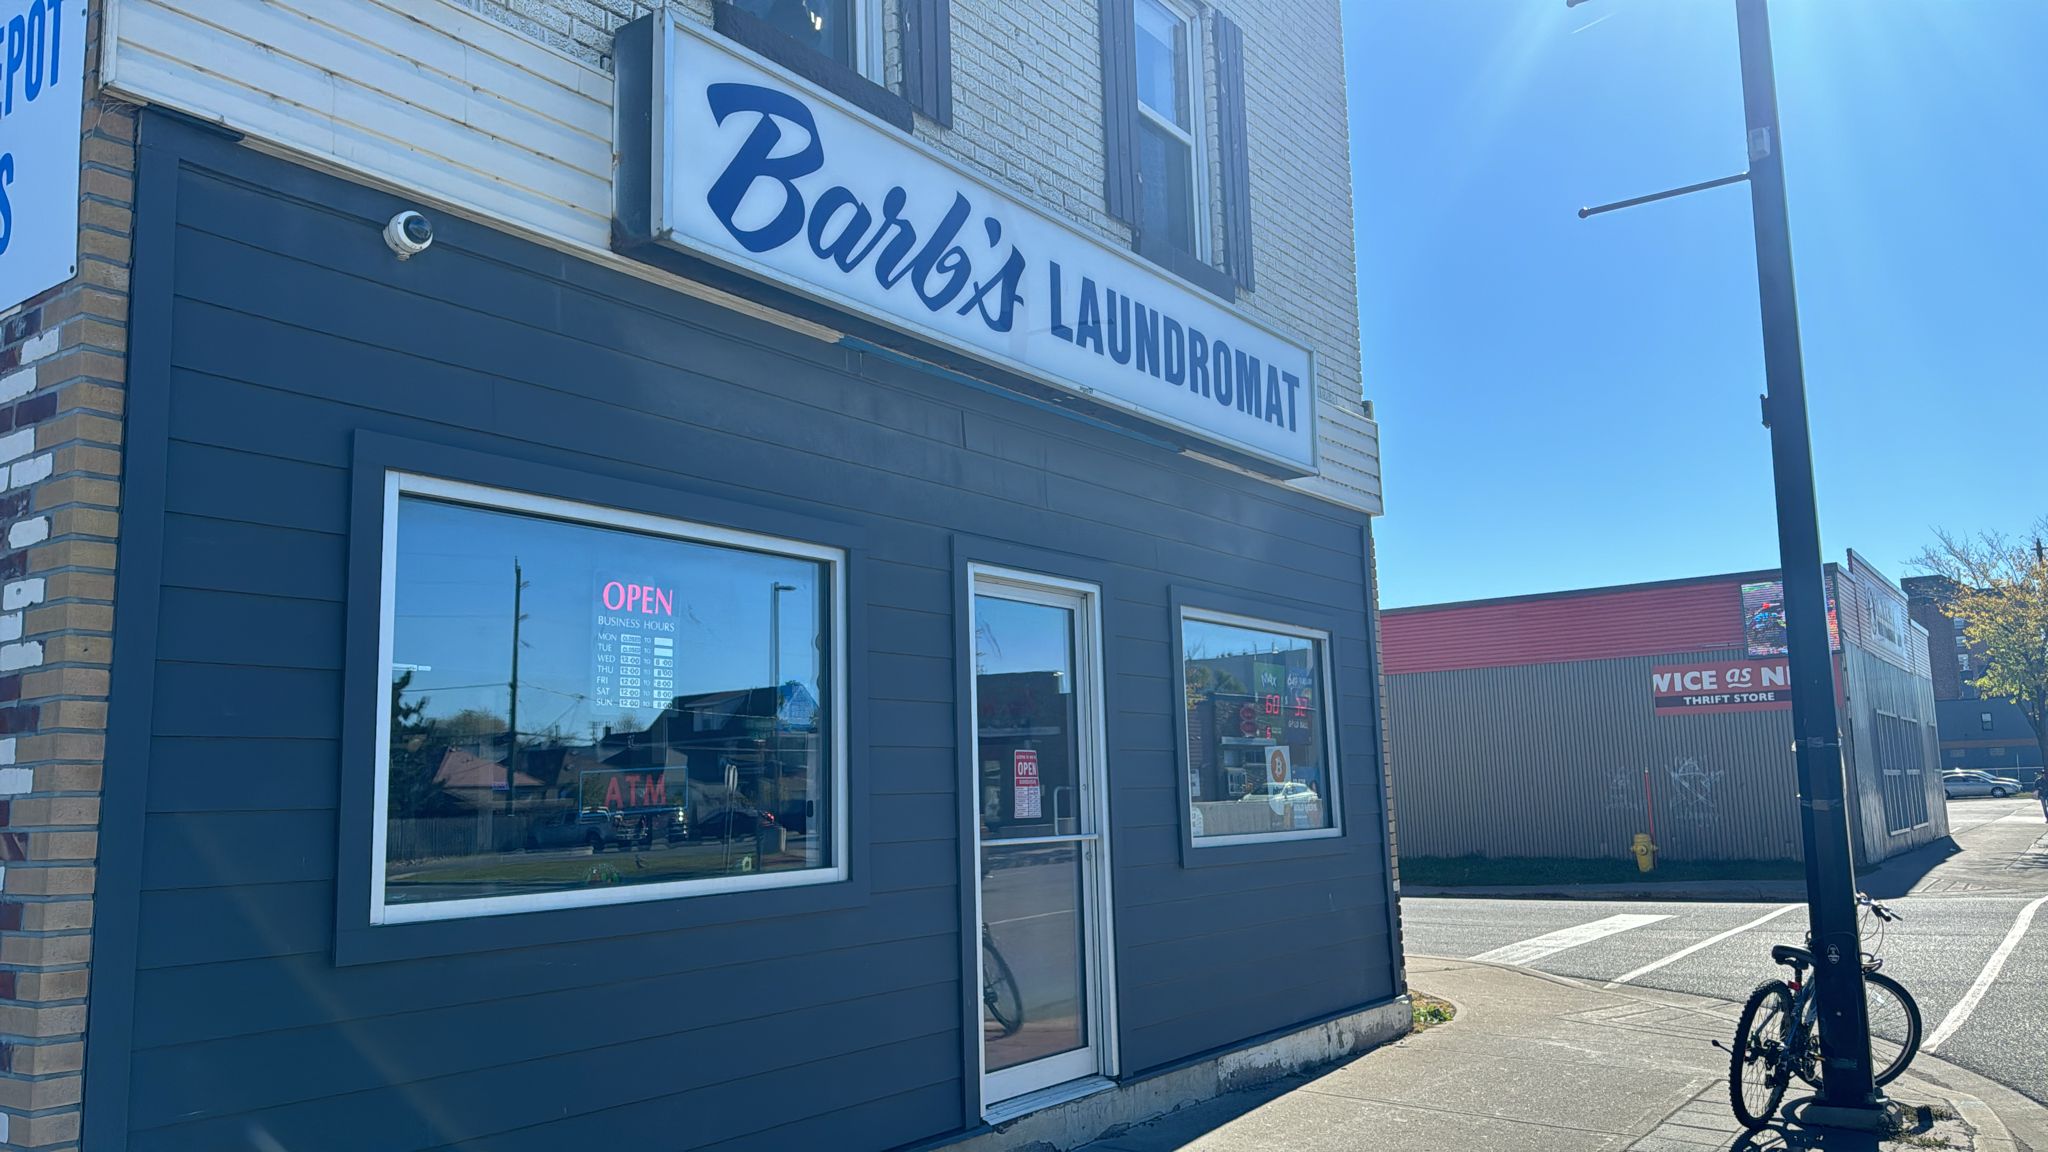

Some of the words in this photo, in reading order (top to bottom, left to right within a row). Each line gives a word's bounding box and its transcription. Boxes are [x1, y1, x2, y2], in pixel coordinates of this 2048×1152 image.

[0, 0, 64, 120] POT
[706, 82, 1025, 333] Barb's
[1049, 260, 1299, 433] LAUNDROMAT
[602, 581, 673, 616] OPEN
[598, 615, 640, 629] BUSINESS
[644, 621, 674, 632] HOURS
[597, 632, 617, 641] MON
[598, 643, 612, 652] TUE
[597, 655, 615, 663] WED
[598, 665, 614, 674] THU
[1725, 667, 1753, 683] as
[596, 676, 608, 684] FRI
[596, 687, 610, 695] SAT
[596, 698, 613, 706] SUN
[1683, 694, 1730, 705] THRIFT
[1734, 692, 1775, 703] STORE
[1018, 761, 1037, 776] OPEN
[603, 773, 667, 810] ATM
